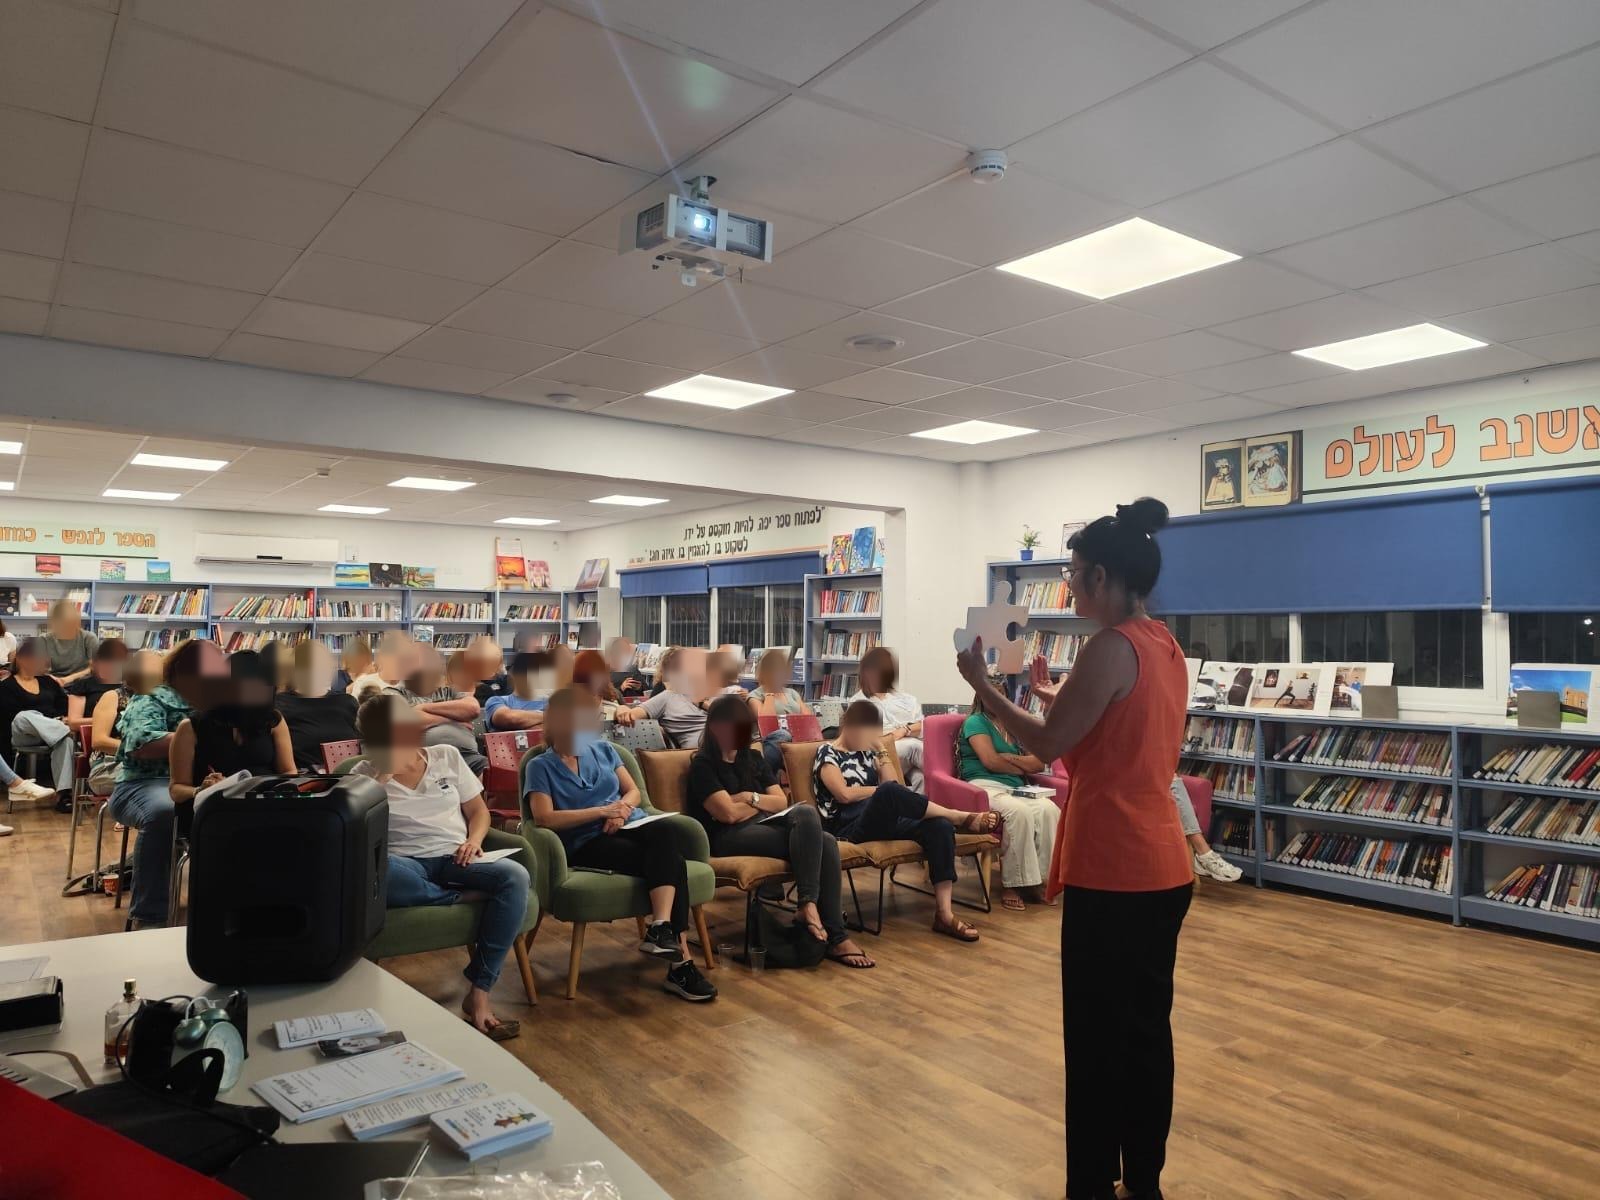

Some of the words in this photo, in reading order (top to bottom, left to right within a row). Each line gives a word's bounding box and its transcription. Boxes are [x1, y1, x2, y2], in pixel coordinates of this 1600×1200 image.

[1479, 405, 1600, 462] אשנב
[1325, 414, 1456, 479] לעולם
[708, 522, 731, 538] מוקסם
[734, 515, 754, 534] להיות
[775, 514, 791, 529] ספר
[61, 527, 106, 545] לנפש
[113, 531, 156, 547] הספר
[696, 523, 706, 539] על
[661, 547, 675, 561] איזה
[688, 540, 710, 560] להאמין
[725, 536, 748, 555] לשקוע
